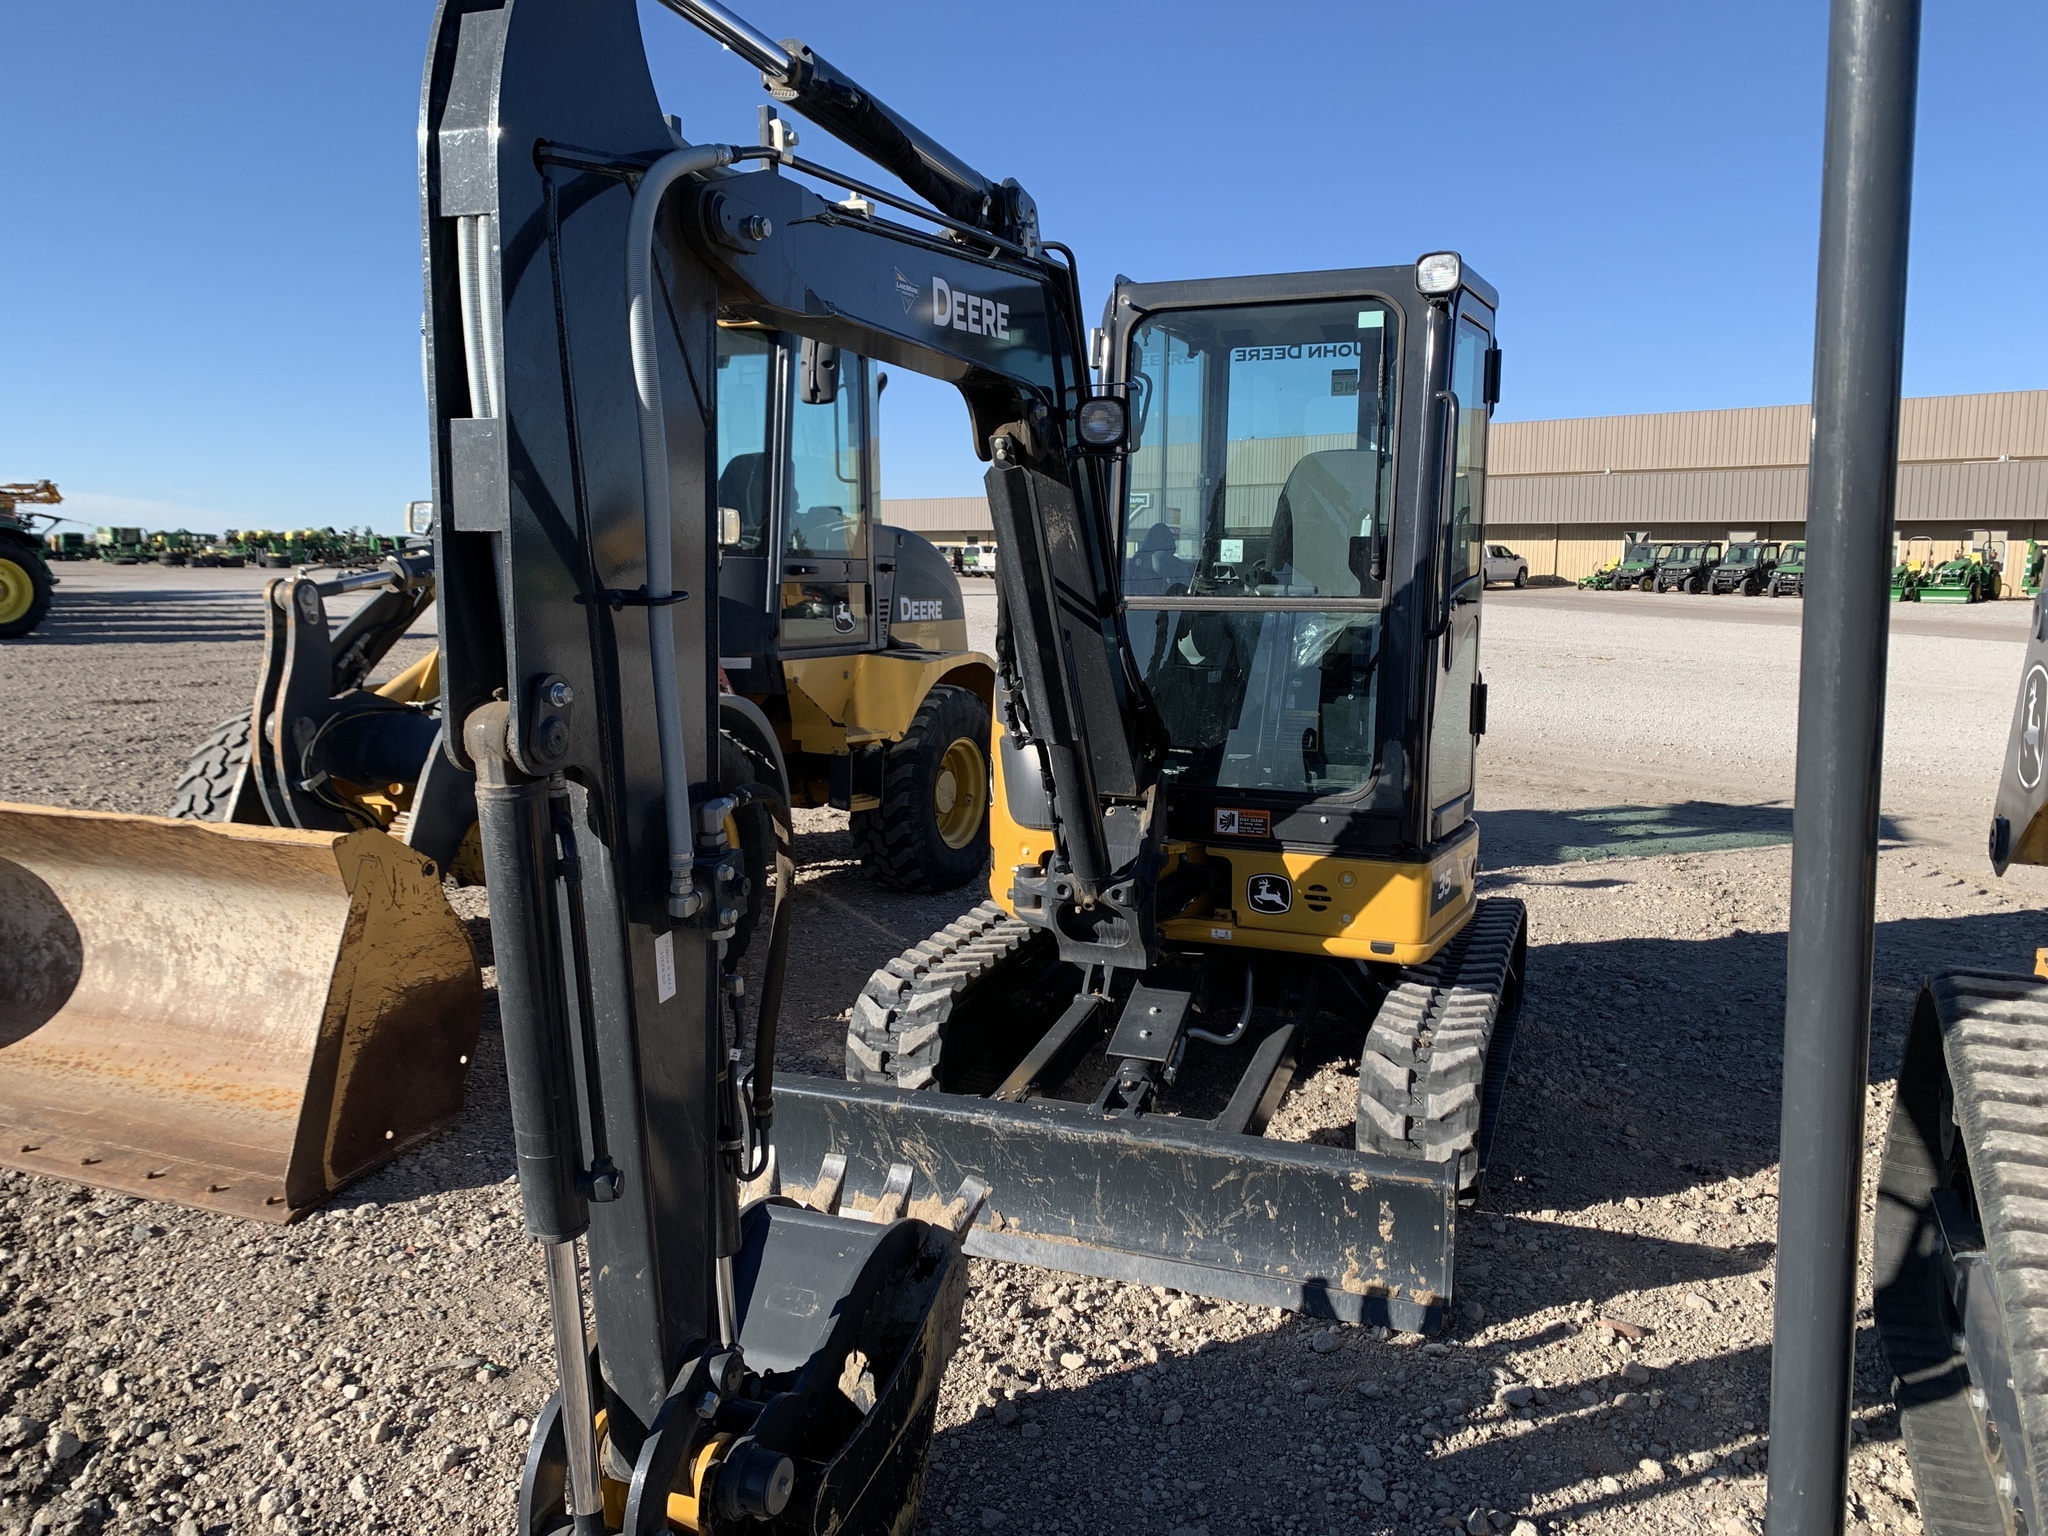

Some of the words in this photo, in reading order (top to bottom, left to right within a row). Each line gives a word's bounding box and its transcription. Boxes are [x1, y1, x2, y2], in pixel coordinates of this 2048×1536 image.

[932, 276, 1010, 341] DEERE
[900, 597, 943, 621] DEERE
[1437, 867, 1452, 900] 35
